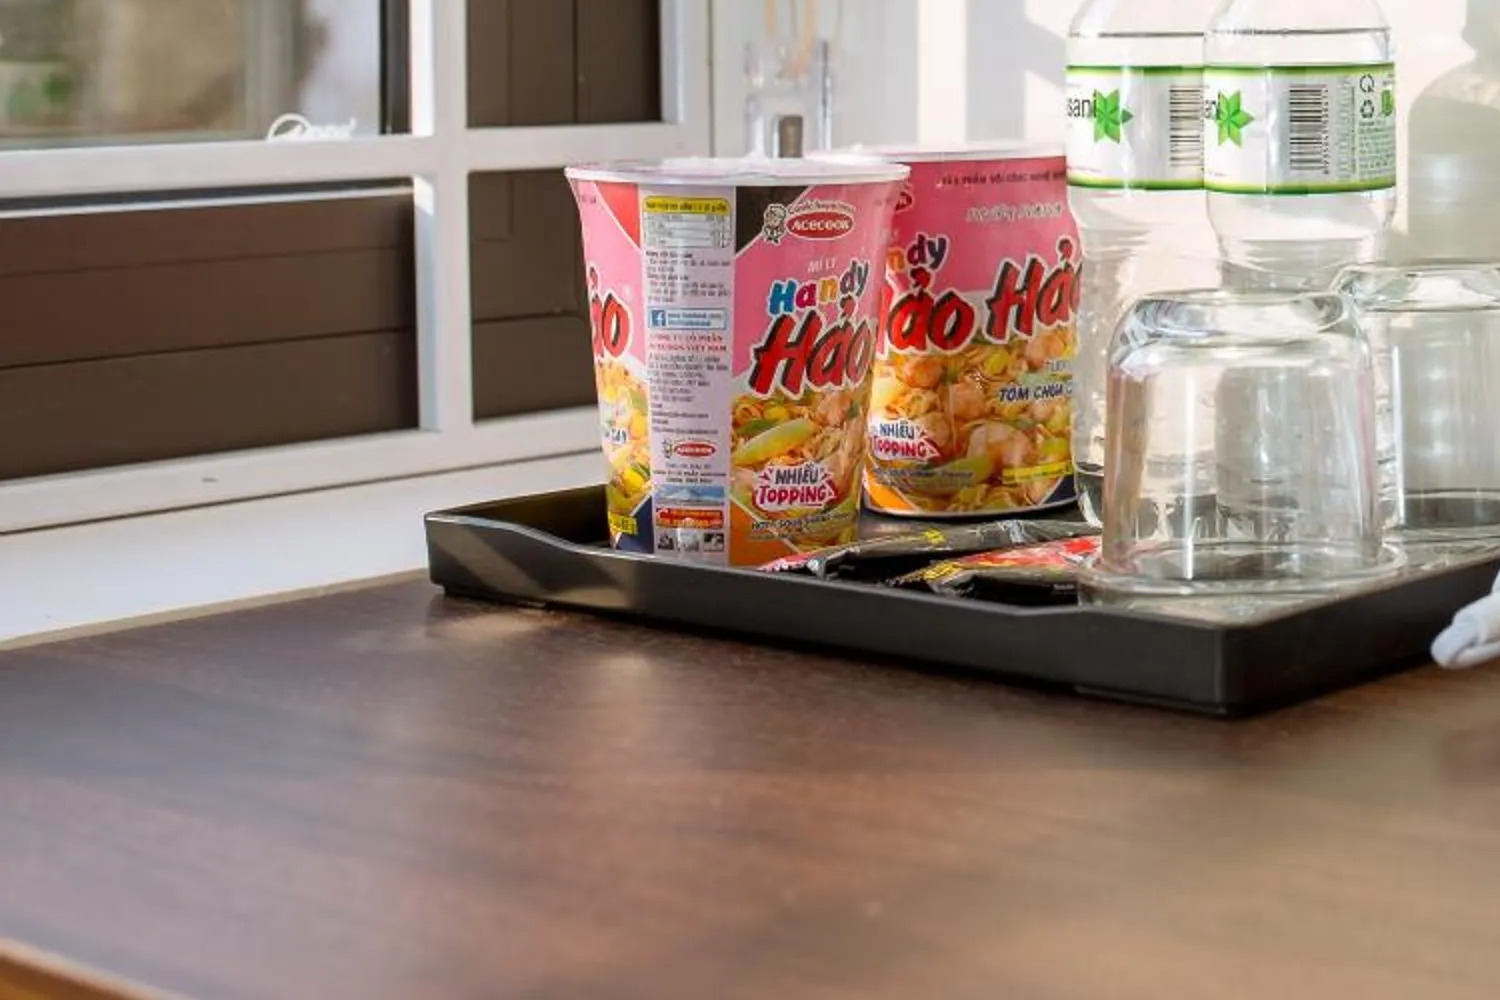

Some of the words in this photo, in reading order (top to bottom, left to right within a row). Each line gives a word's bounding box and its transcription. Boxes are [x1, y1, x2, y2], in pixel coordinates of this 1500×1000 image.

[792, 219, 850, 232] ACECOOK
[769, 259, 869, 316] Handy
[749, 295, 875, 395] Hảo
